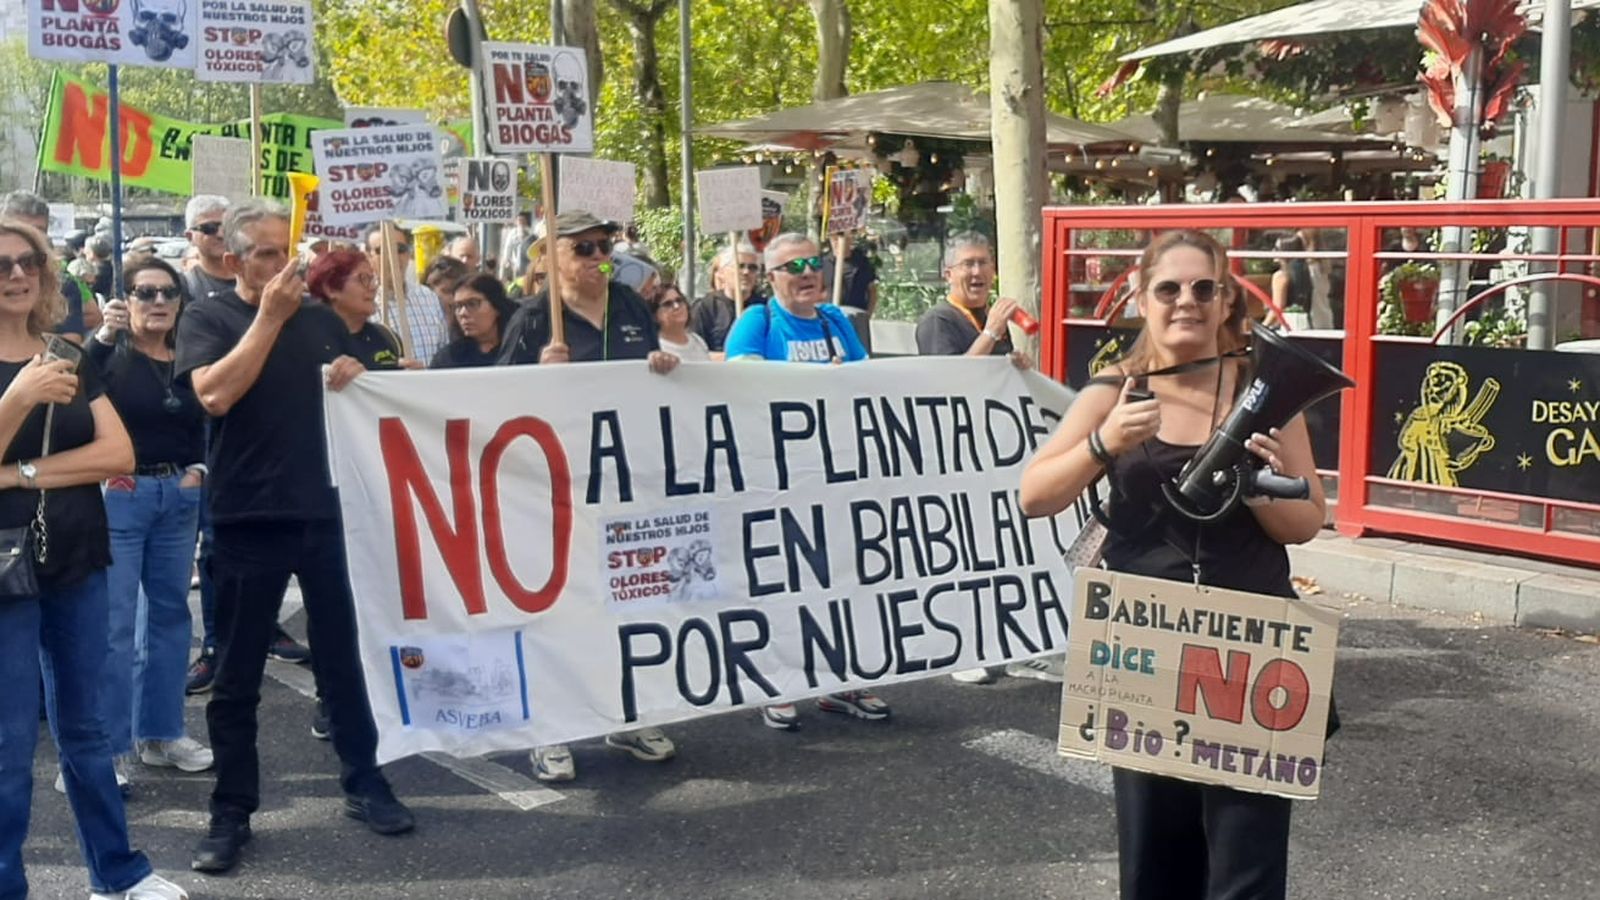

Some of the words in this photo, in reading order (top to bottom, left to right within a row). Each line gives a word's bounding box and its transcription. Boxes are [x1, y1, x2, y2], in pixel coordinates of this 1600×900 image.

[203, 11, 267, 22] NUESTROS
[270, 14, 305, 24] HIJOS
[230, 4, 246, 12] LA
[250, 5, 286, 14] SALUD
[289, 6, 305, 14] DE
[41, 16, 119, 34] PLANTA
[205, 48, 263, 61] OLORES
[493, 63, 553, 105] NO
[497, 107, 553, 121] PLANTA
[353, 137, 368, 145] LA
[372, 133, 412, 144] SALUD
[416, 131, 432, 141] DE
[325, 145, 393, 158] NUESTROS
[396, 142, 434, 153] HIJOS
[467, 160, 510, 192] NO
[331, 185, 392, 202] OLORES
[585, 409, 633, 504] A
[659, 404, 745, 497] LA
[769, 397, 983, 490] PLANTA
[378, 415, 574, 620] NO
[635, 519, 650, 530] LA
[654, 514, 691, 528] SALUD
[694, 511, 709, 521] DE
[606, 527, 672, 545] NUESTROS
[675, 522, 710, 536] HIJOS
[742, 504, 831, 598] EN
[610, 570, 671, 589] OLORES
[618, 609, 782, 724] POR
[797, 570, 1069, 689] NUESTRA
[1175, 643, 1310, 732] NO
[1191, 738, 1318, 787] METANO
